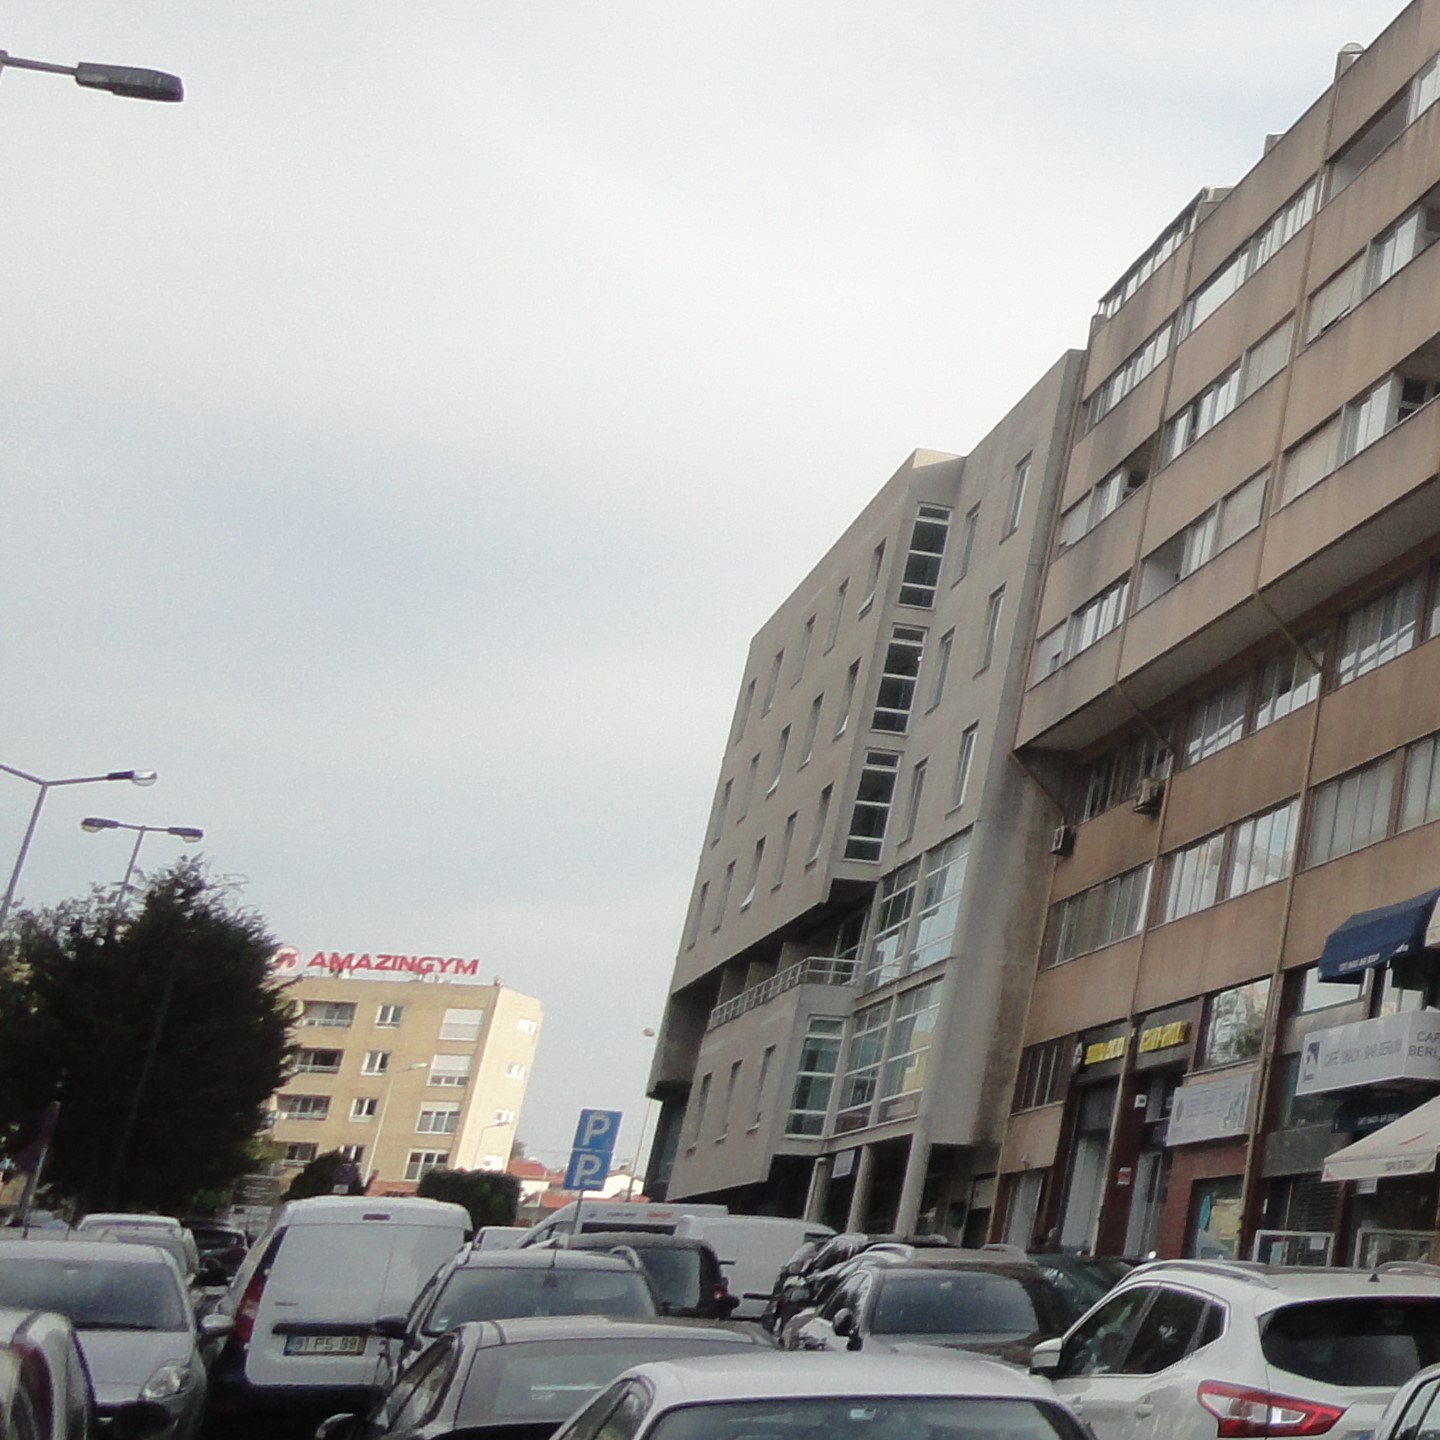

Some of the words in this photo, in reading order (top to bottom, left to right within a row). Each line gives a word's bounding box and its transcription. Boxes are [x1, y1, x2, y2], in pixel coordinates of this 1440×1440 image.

[306, 951, 480, 976] AMAZINGYM
[583, 1113, 611, 1147] P
[573, 1153, 601, 1187] P
